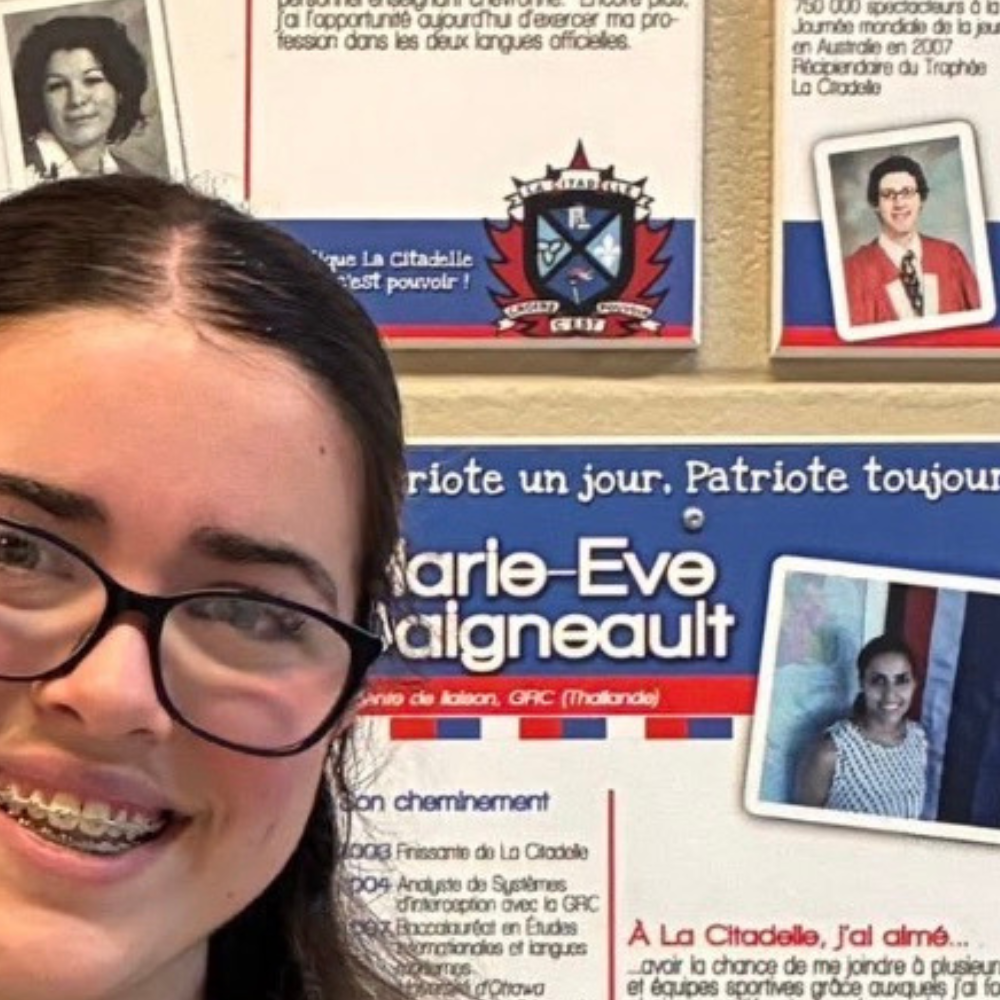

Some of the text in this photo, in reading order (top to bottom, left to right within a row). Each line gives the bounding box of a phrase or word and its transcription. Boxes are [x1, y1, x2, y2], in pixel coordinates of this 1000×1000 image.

[606, 12, 635, 28] ma
[344, 31, 388, 51] dans
[395, 31, 419, 51] les
[792, 78, 812, 95] La
[362, 249, 384, 266] La
[390, 249, 473, 266] Citadelle
[386, 272, 459, 293] pouvoir
[405, 461, 505, 494] riote
[518, 470, 570, 493] un
[686, 459, 849, 492] Patriote
[862, 458, 1000, 500] toujour
[475, 843, 495, 860] de
[500, 843, 520, 860] La
[627, 919, 651, 946] À
[660, 924, 695, 946] La
